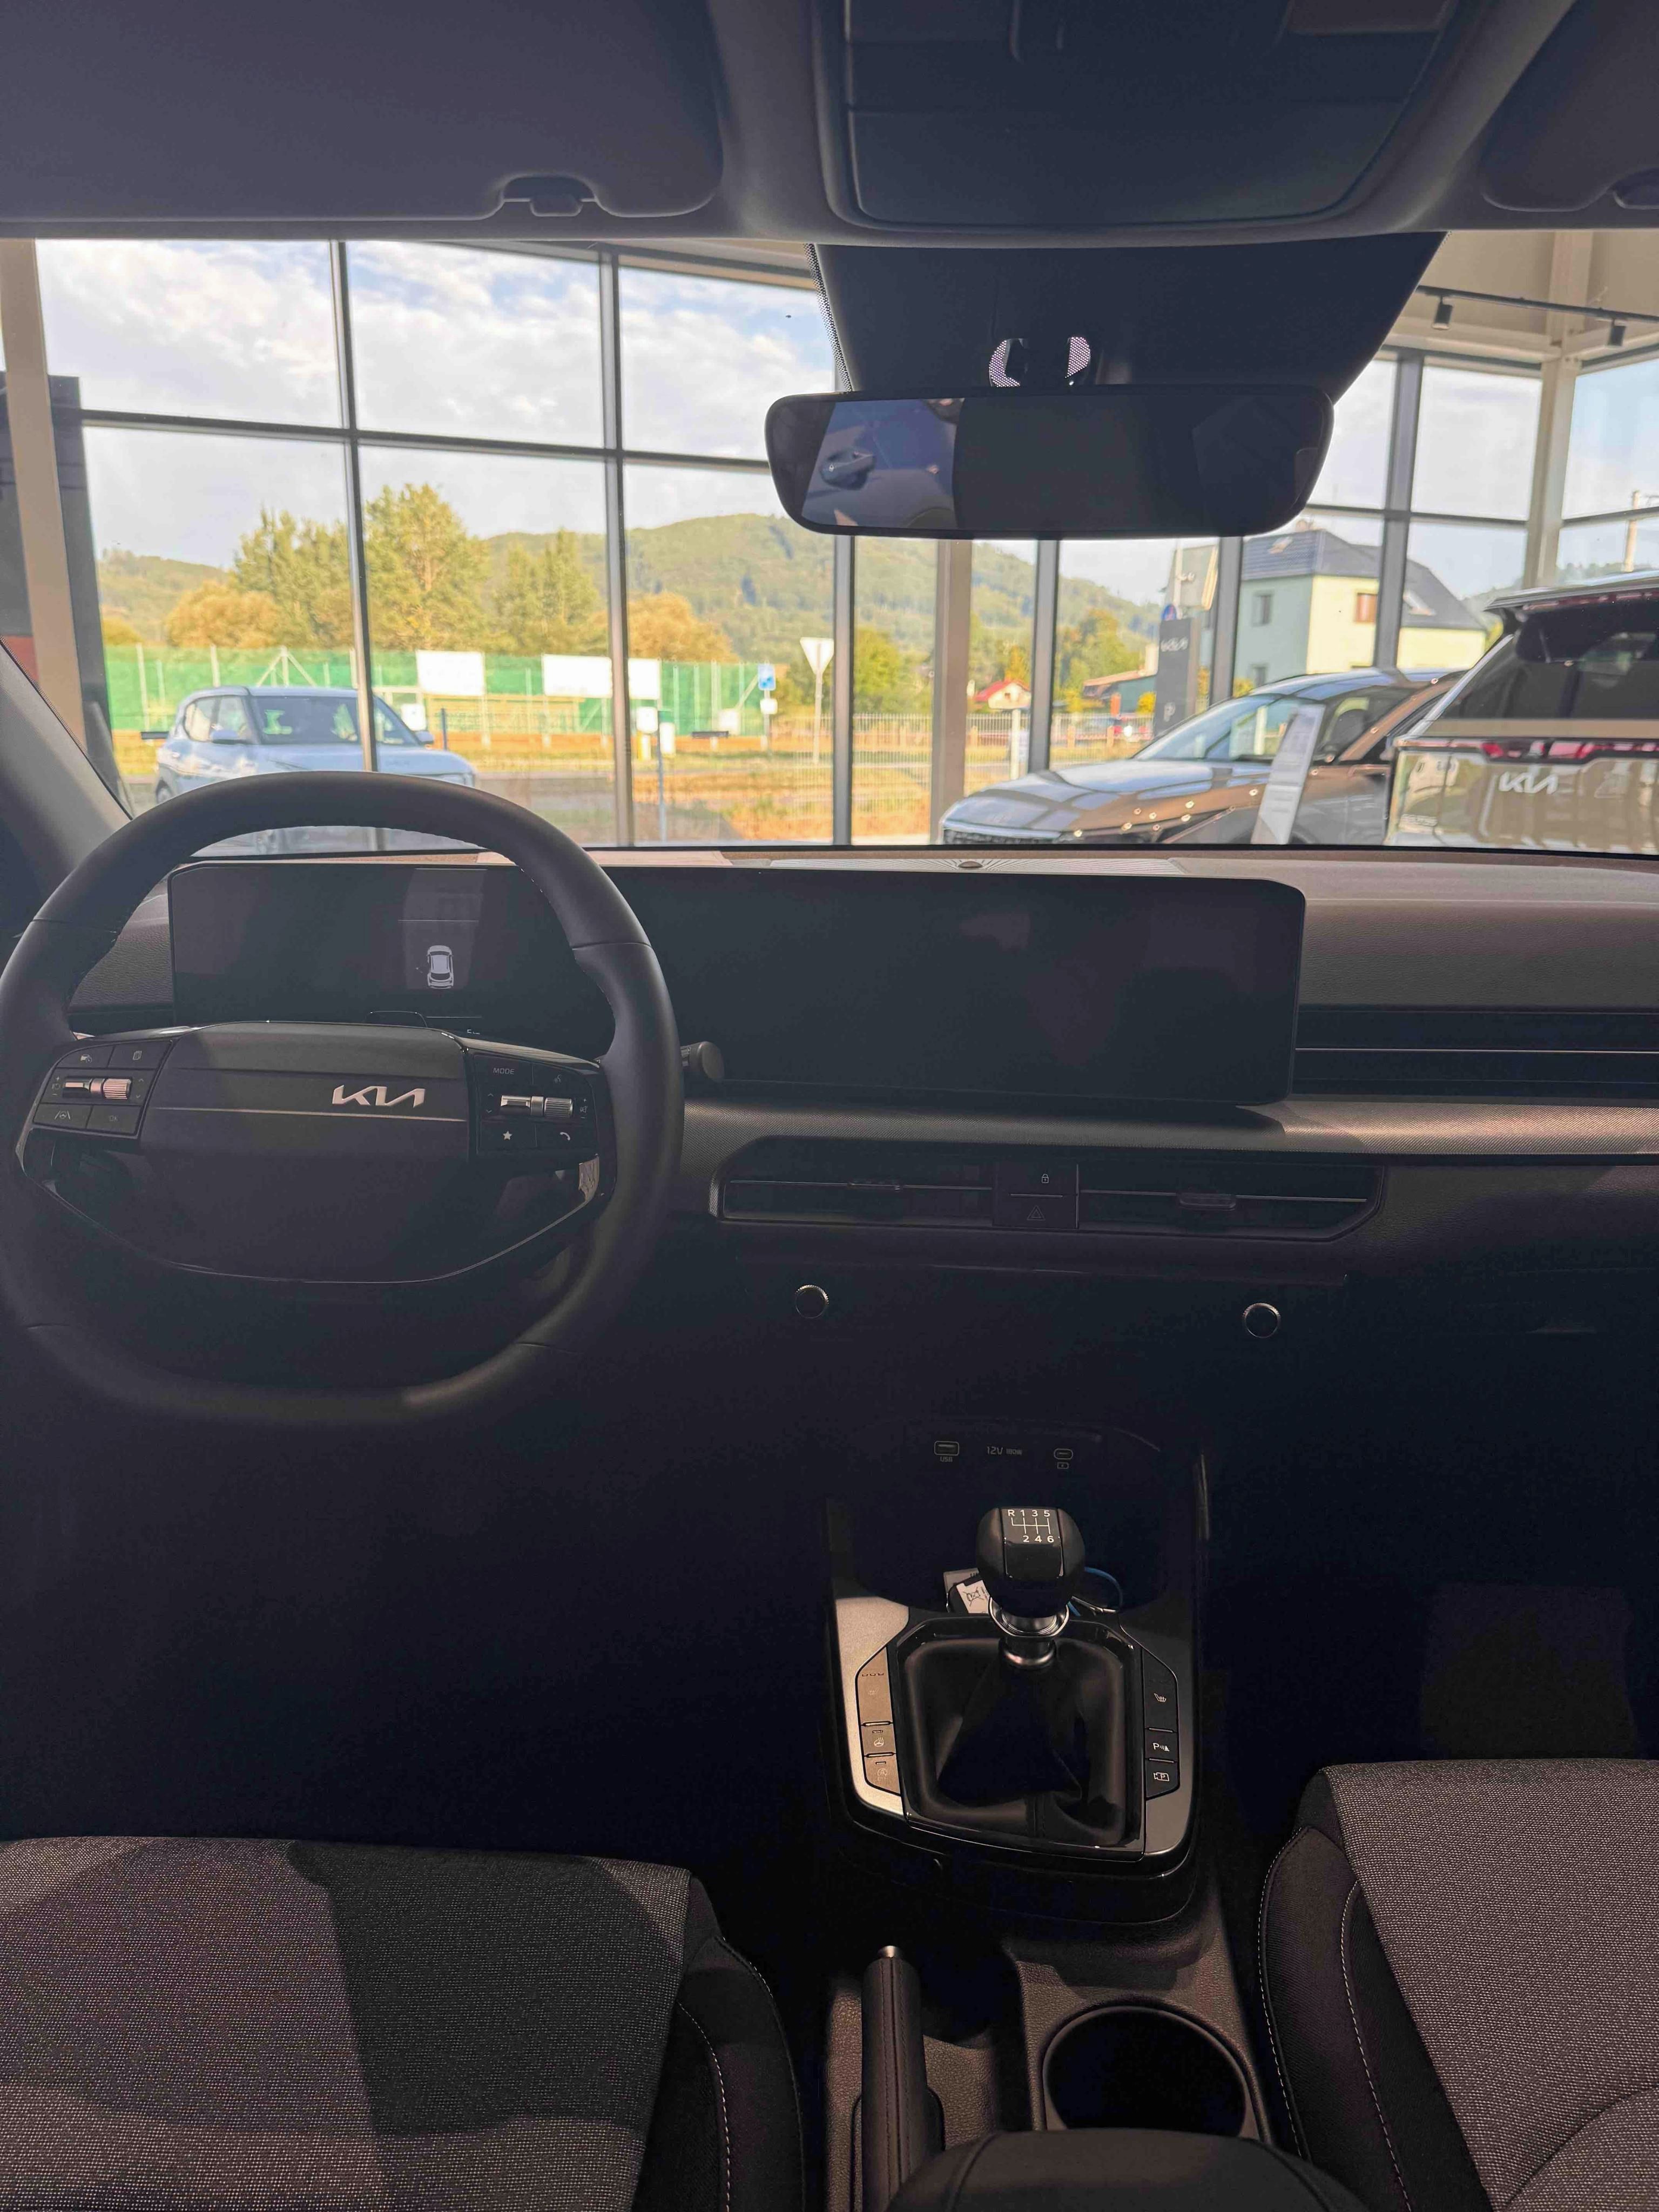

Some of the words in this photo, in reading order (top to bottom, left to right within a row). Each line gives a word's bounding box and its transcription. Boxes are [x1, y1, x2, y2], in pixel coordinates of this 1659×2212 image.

[1499, 771, 1558, 794] KIA
[493, 1067, 515, 1075] MODE
[332, 1084, 426, 1108] KIA
[987, 1446, 1003, 1455] 12V
